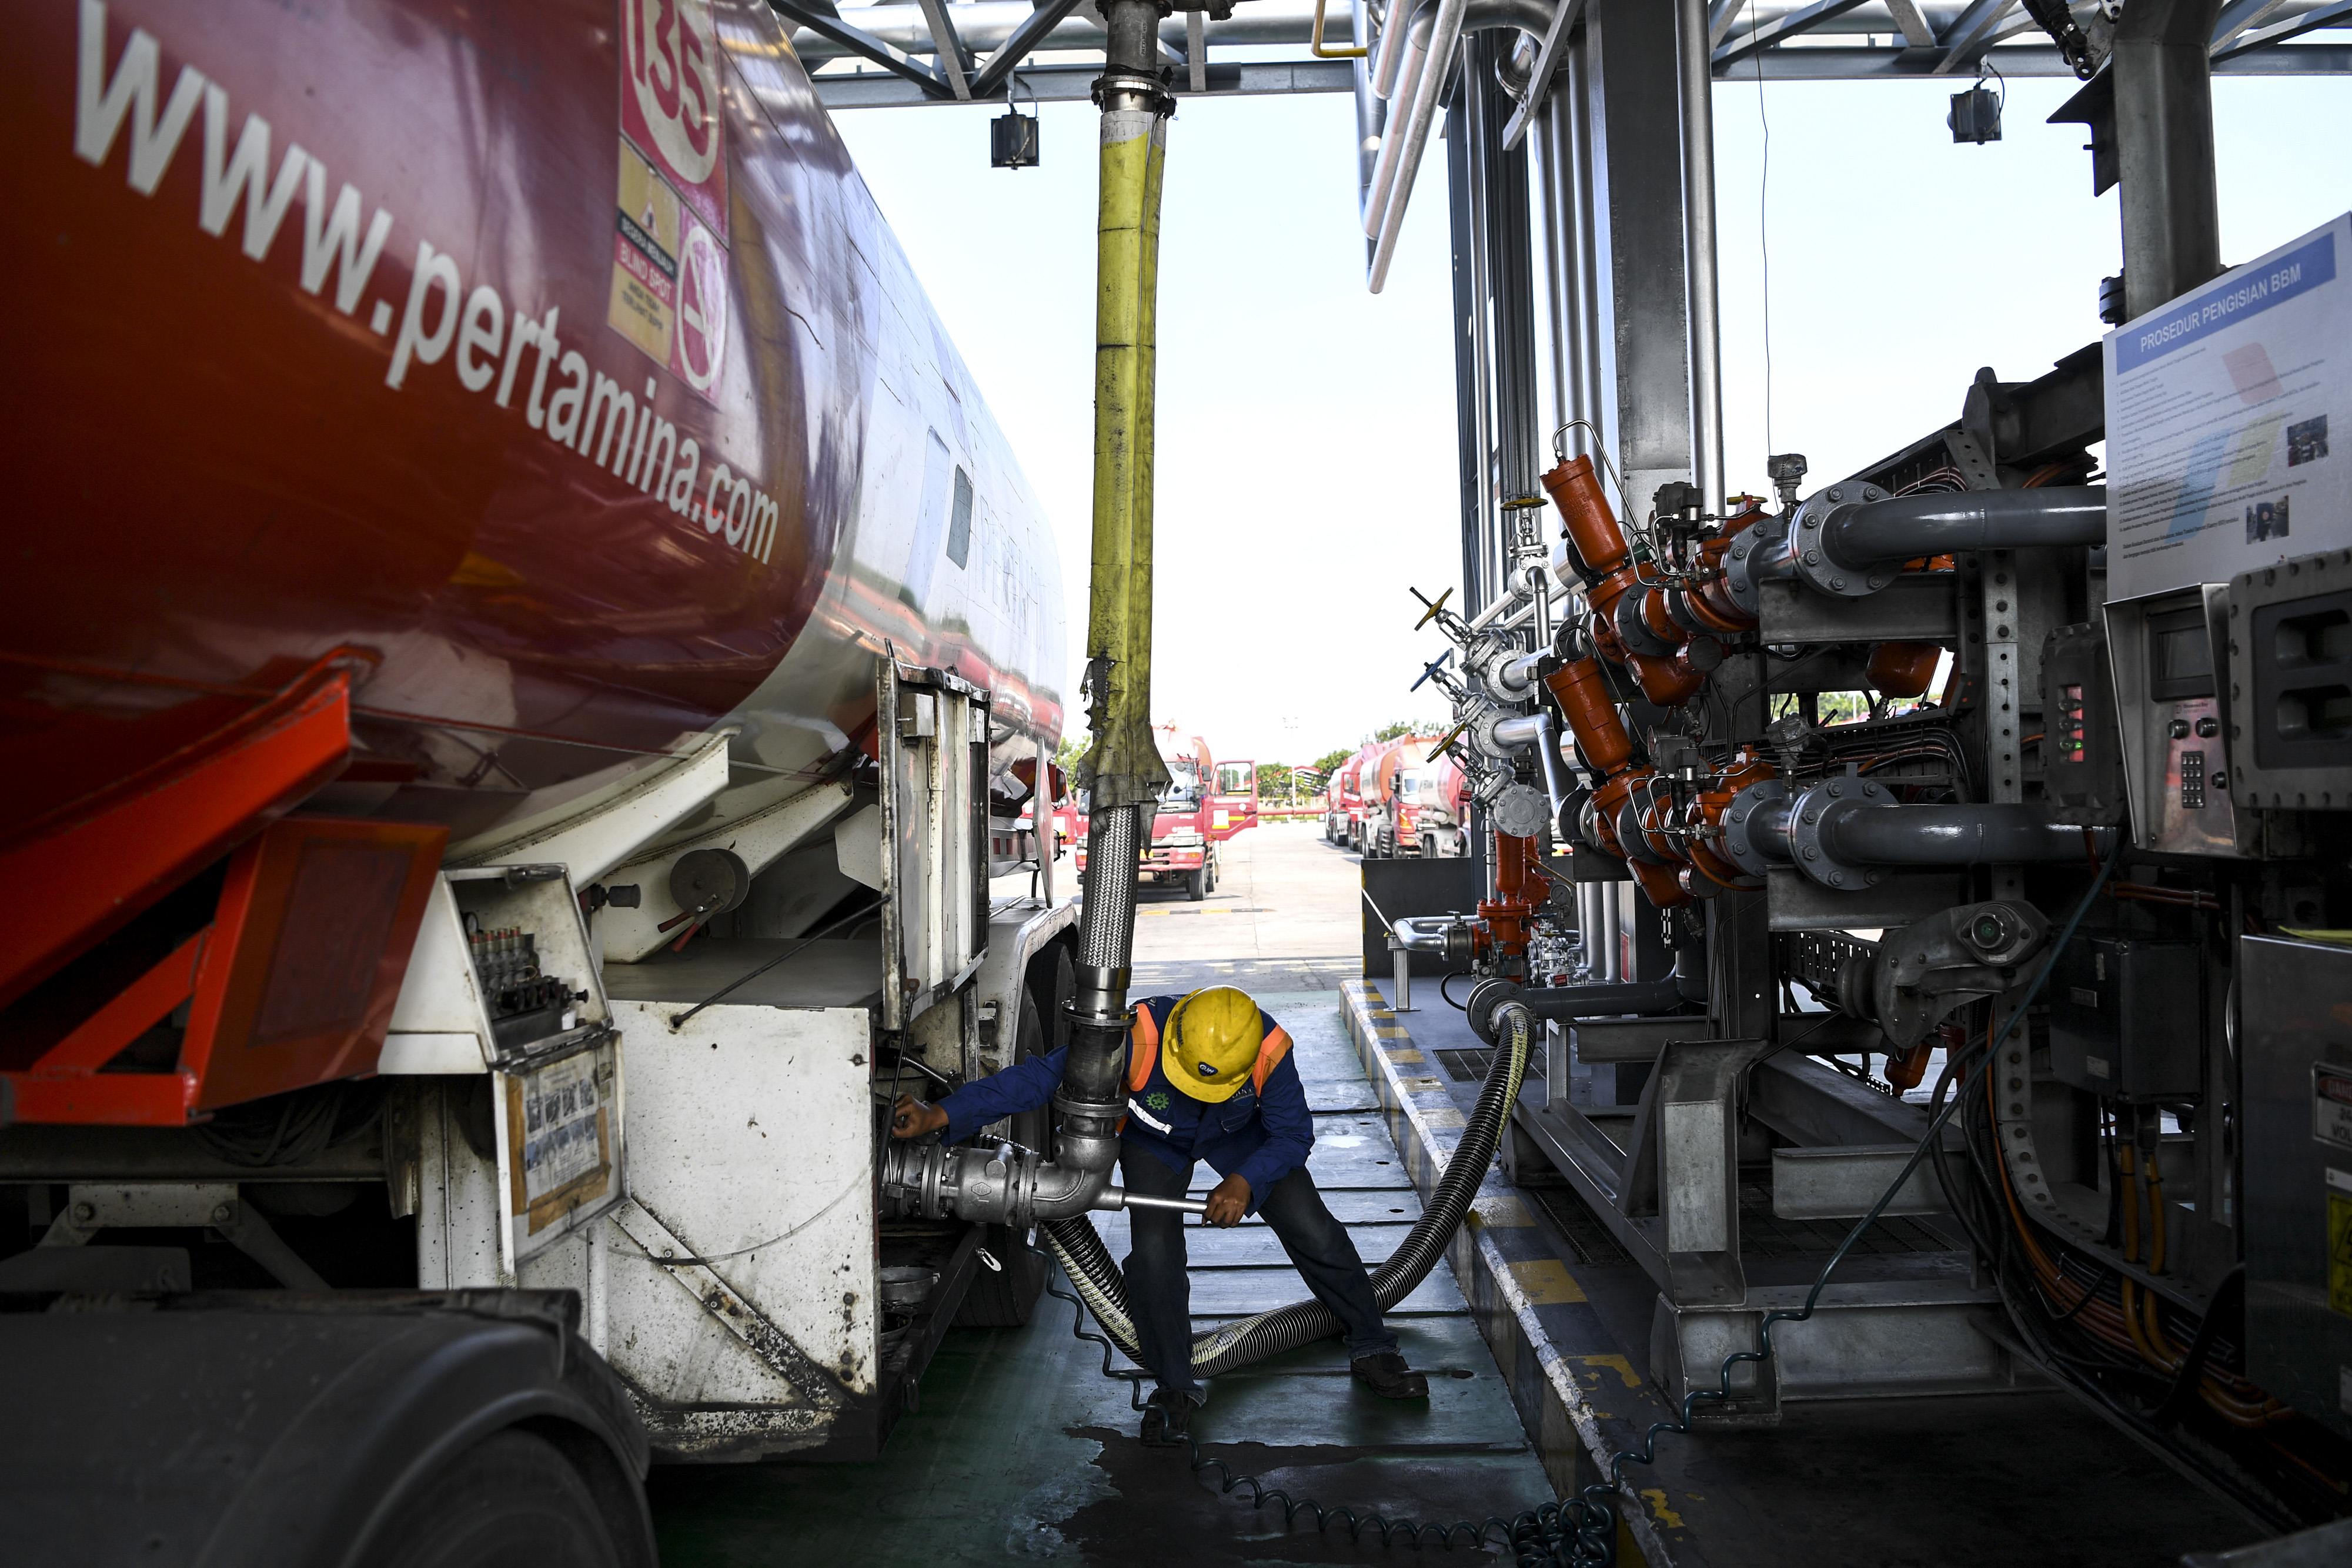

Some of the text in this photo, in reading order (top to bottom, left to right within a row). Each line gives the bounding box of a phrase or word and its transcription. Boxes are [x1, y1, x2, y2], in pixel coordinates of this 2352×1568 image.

[73, 0, 780, 565] www.pertamina.com
[620, 241, 671, 302] BLIND SPOT
[2140, 263, 2301, 352] PROSEDUR PENGISIAN BBM
